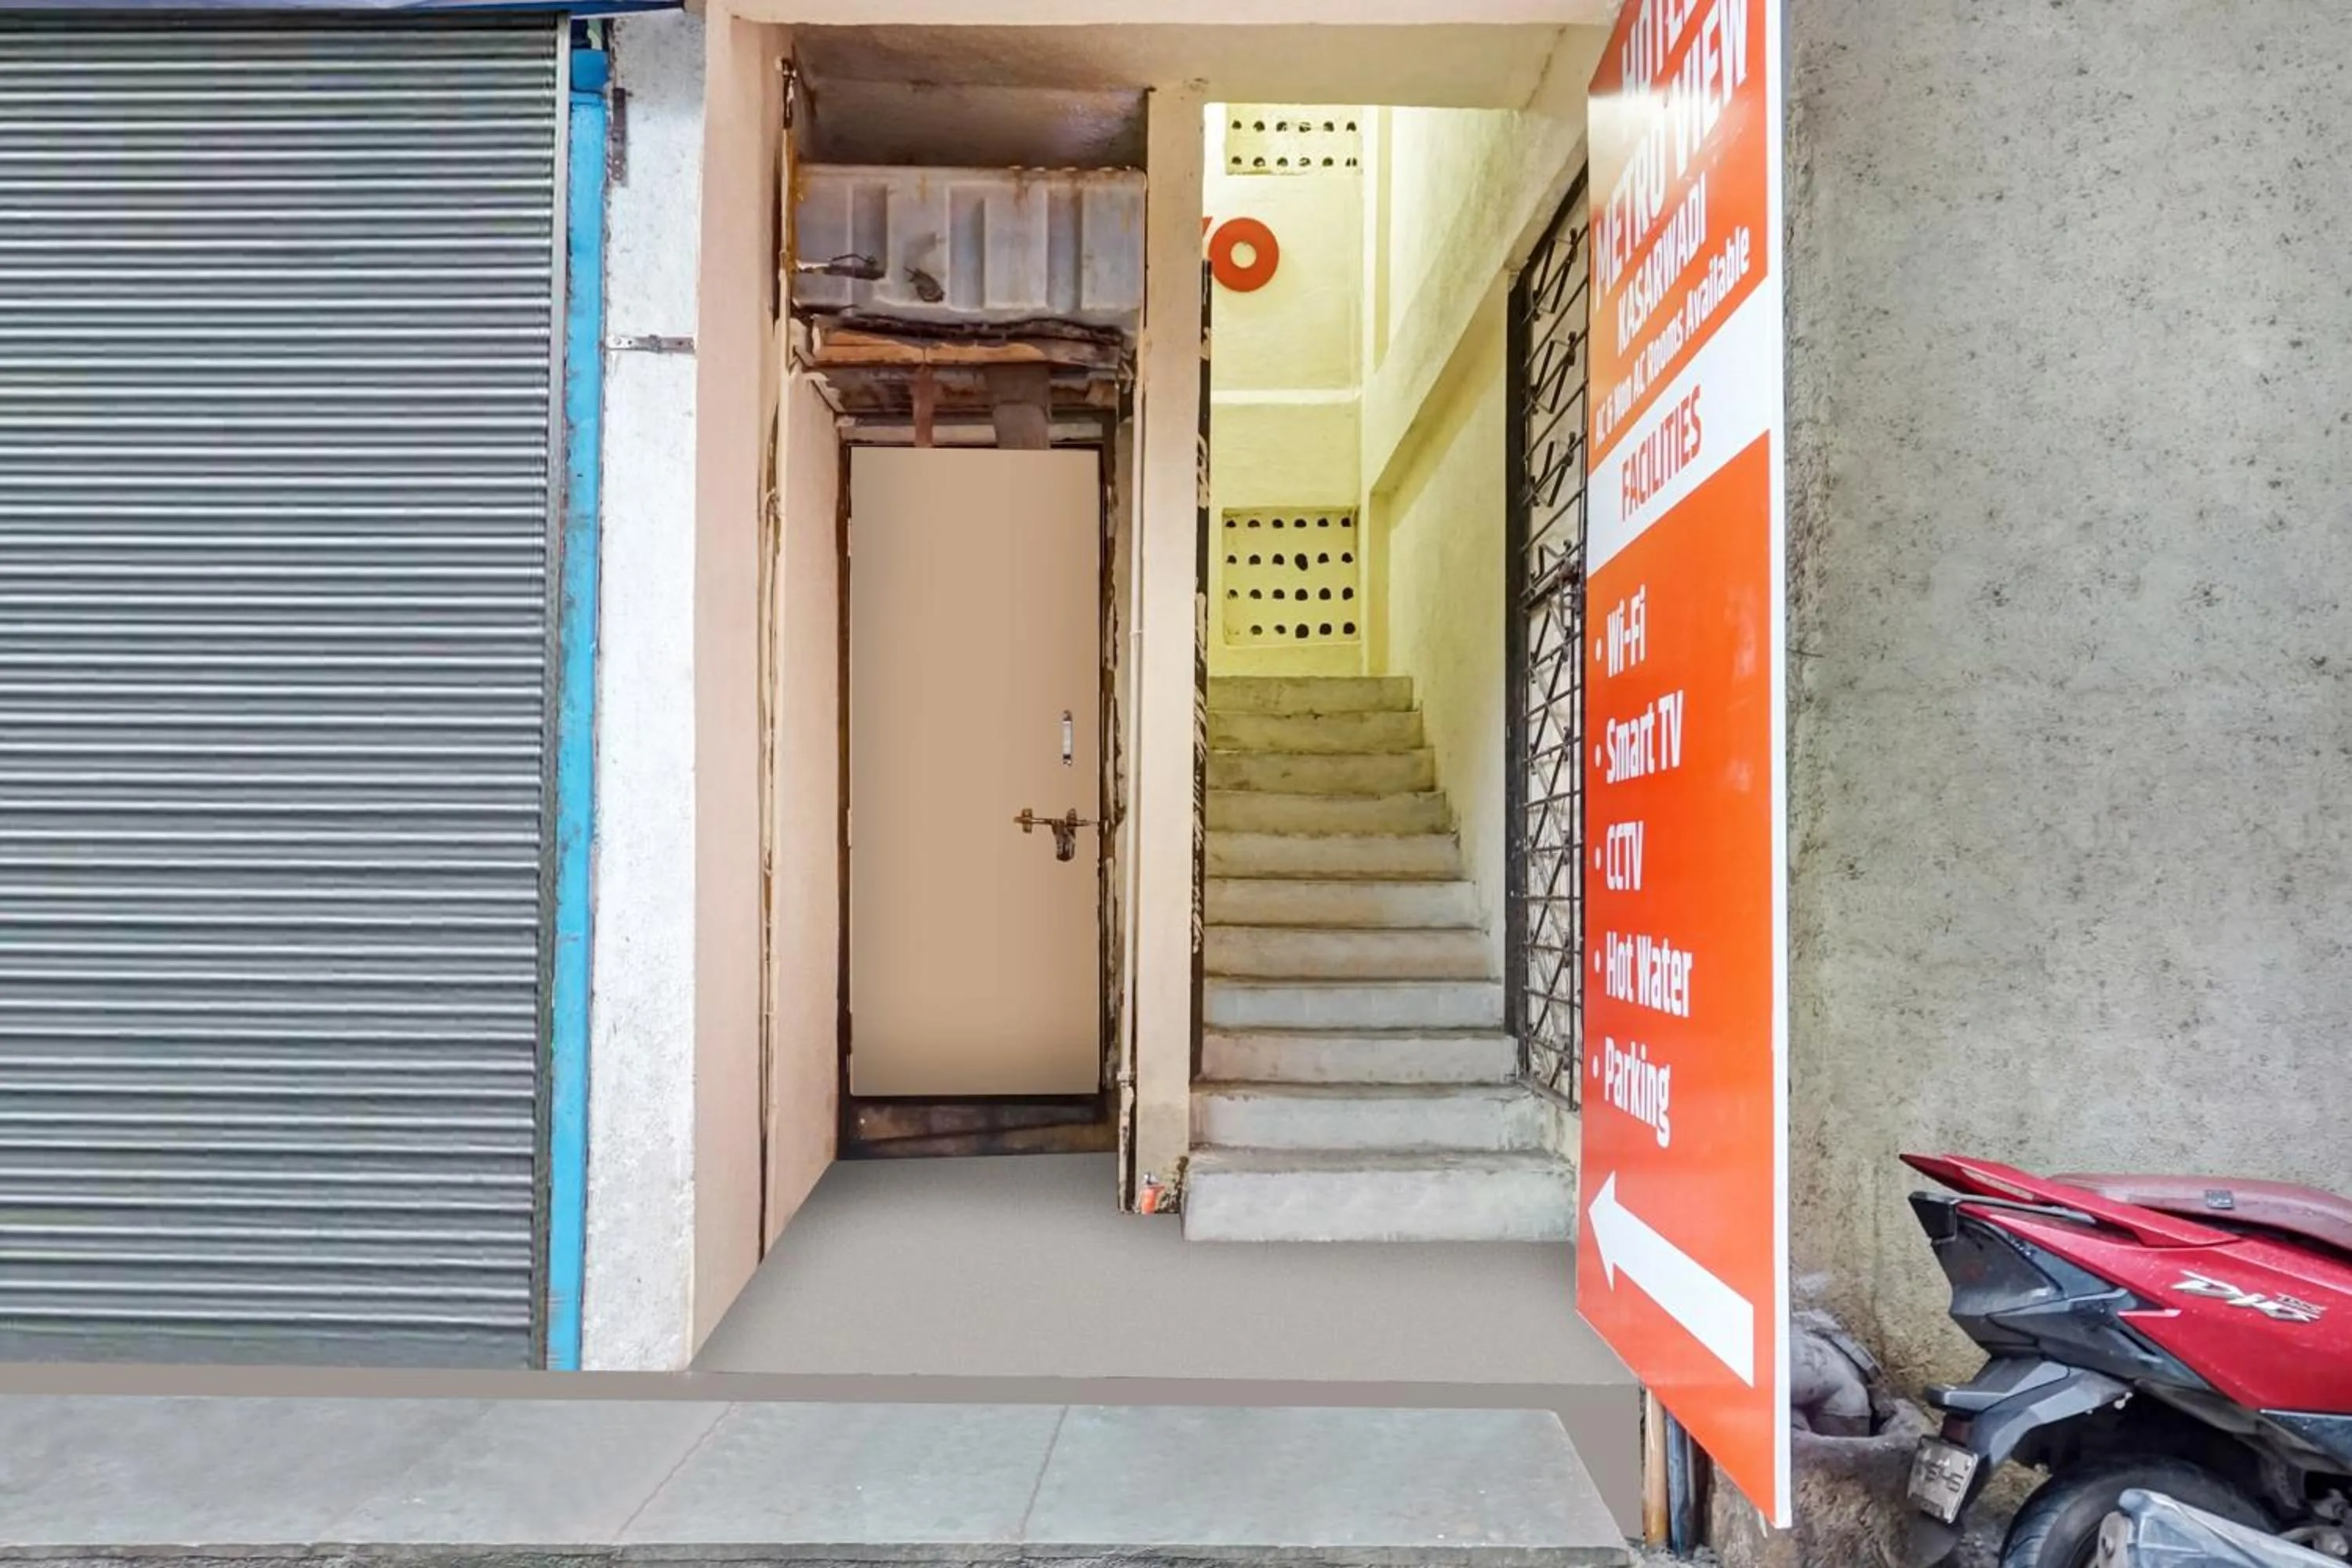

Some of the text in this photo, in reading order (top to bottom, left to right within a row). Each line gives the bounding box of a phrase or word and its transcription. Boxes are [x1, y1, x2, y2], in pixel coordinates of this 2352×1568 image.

[1595, 0, 1748, 311] METRO VIEW
[1617, 170, 1706, 358] KASARWADI
[1685, 226, 1751, 342] Available
[1621, 383, 1702, 521] FACILITIES
[1607, 584, 1646, 677] Wi-Fi
[1606, 689, 1683, 784] Smart TV
[1606, 820, 1643, 891] CCTV
[1606, 931, 1693, 1018] Hot Water
[1605, 1036, 1671, 1149] Parking
